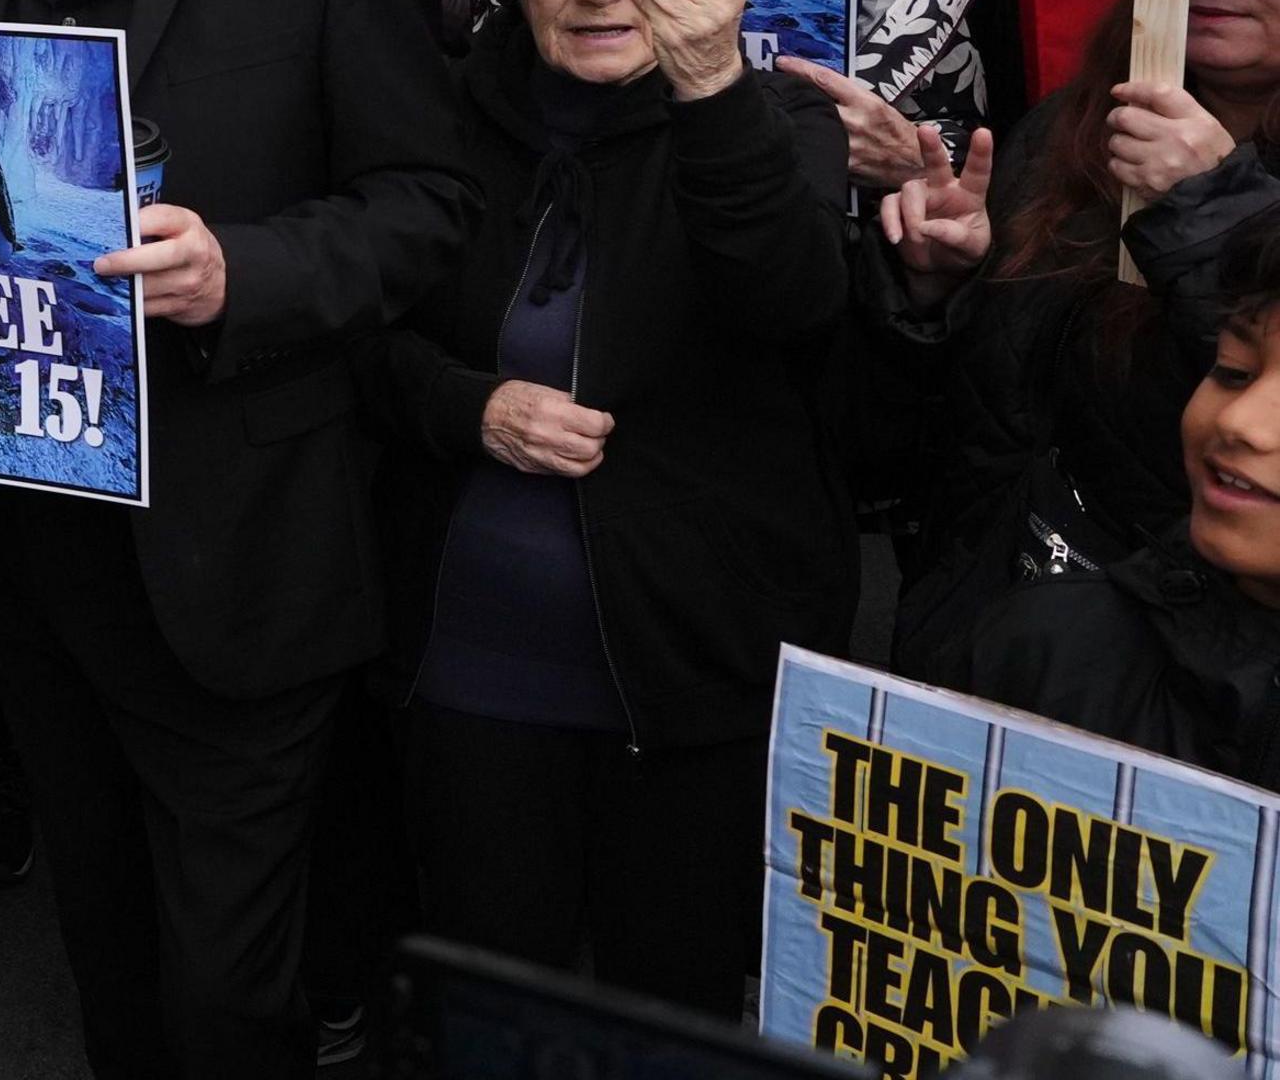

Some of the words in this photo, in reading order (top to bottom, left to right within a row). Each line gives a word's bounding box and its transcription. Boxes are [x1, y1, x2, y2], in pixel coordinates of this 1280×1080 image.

[13, 358, 105, 447] 15!
[825, 732, 965, 862] THE
[991, 792, 1210, 940] ONLY
[790, 813, 1021, 977] THING
[1052, 907, 1242, 1052] YOU
[821, 912, 1064, 1056] TEAC
